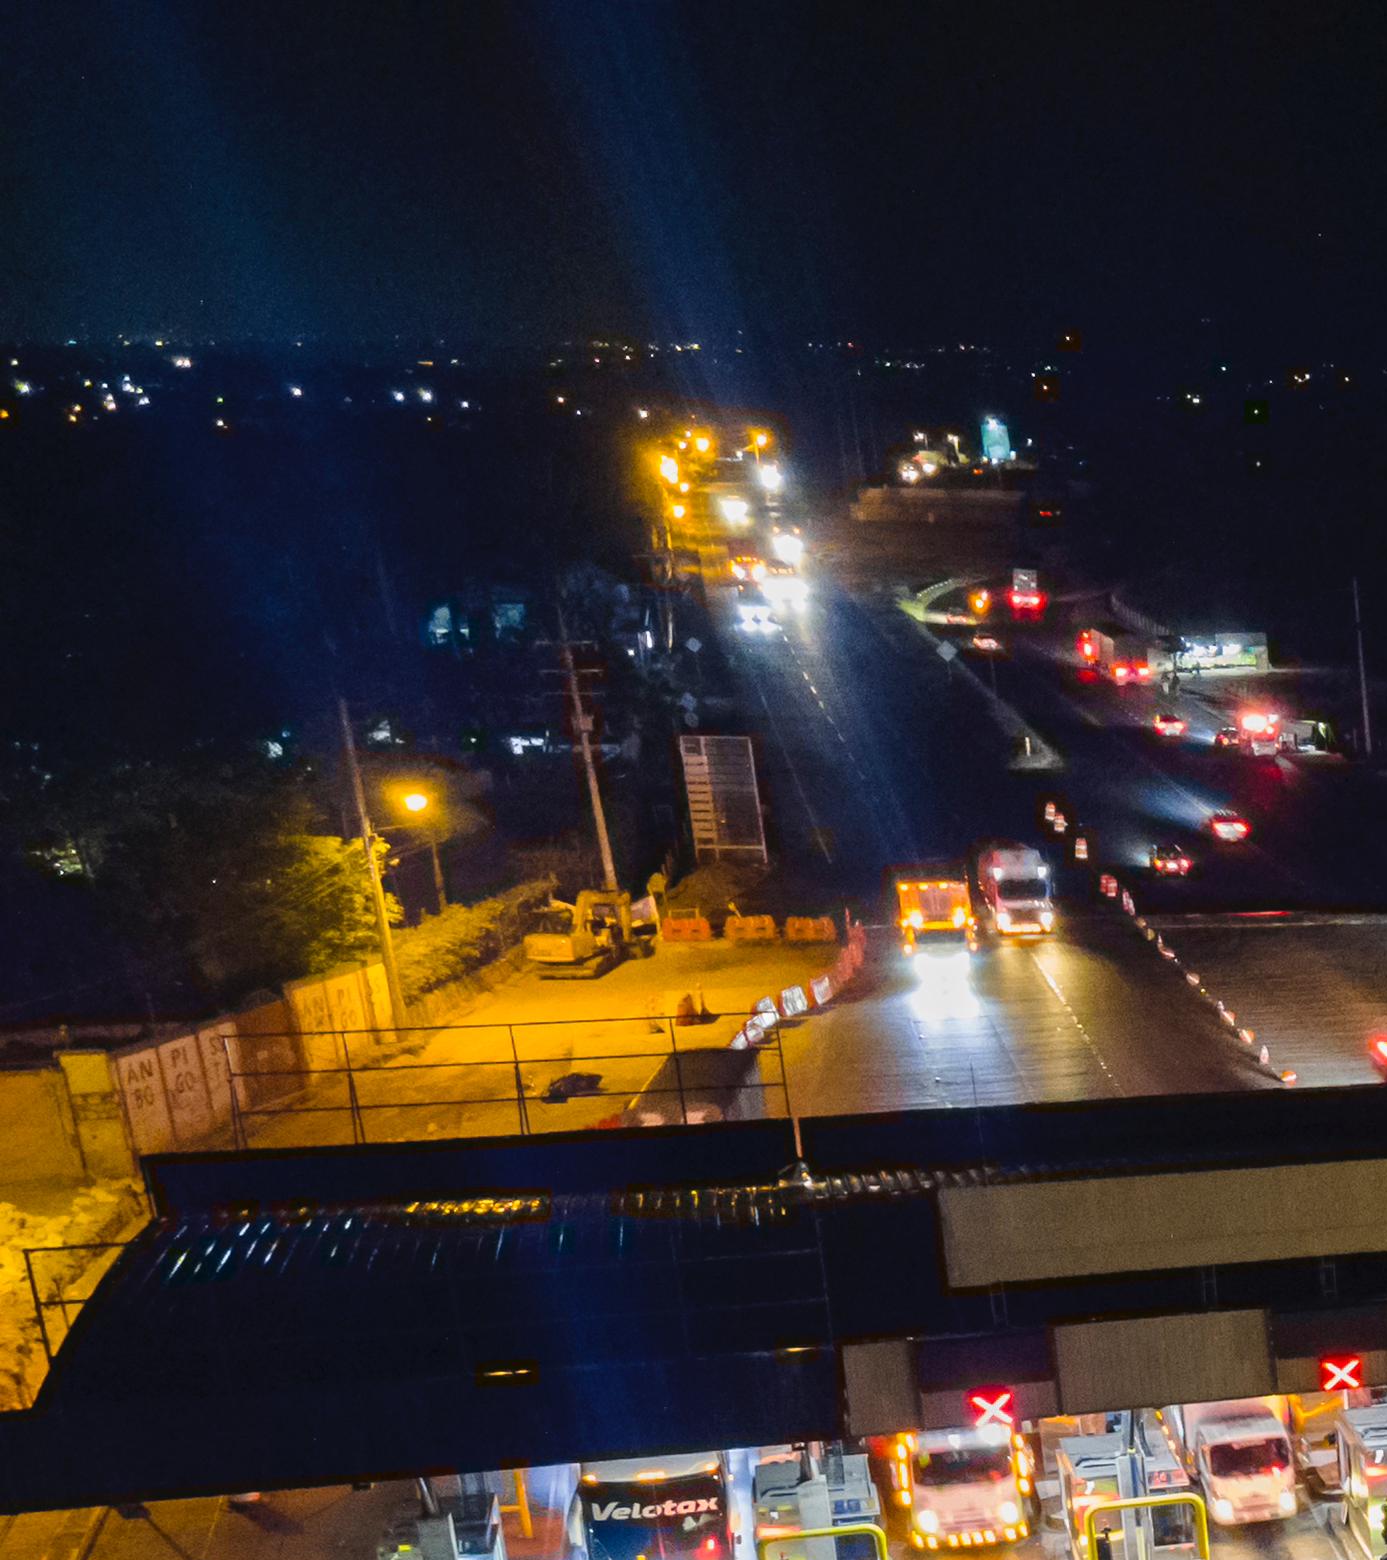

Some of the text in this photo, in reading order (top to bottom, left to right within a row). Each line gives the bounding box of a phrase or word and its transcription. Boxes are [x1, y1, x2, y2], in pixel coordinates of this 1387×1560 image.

[127, 1058, 153, 1084] AN
[170, 1047, 189, 1068] PI
[591, 1497, 719, 1521] Velotax
